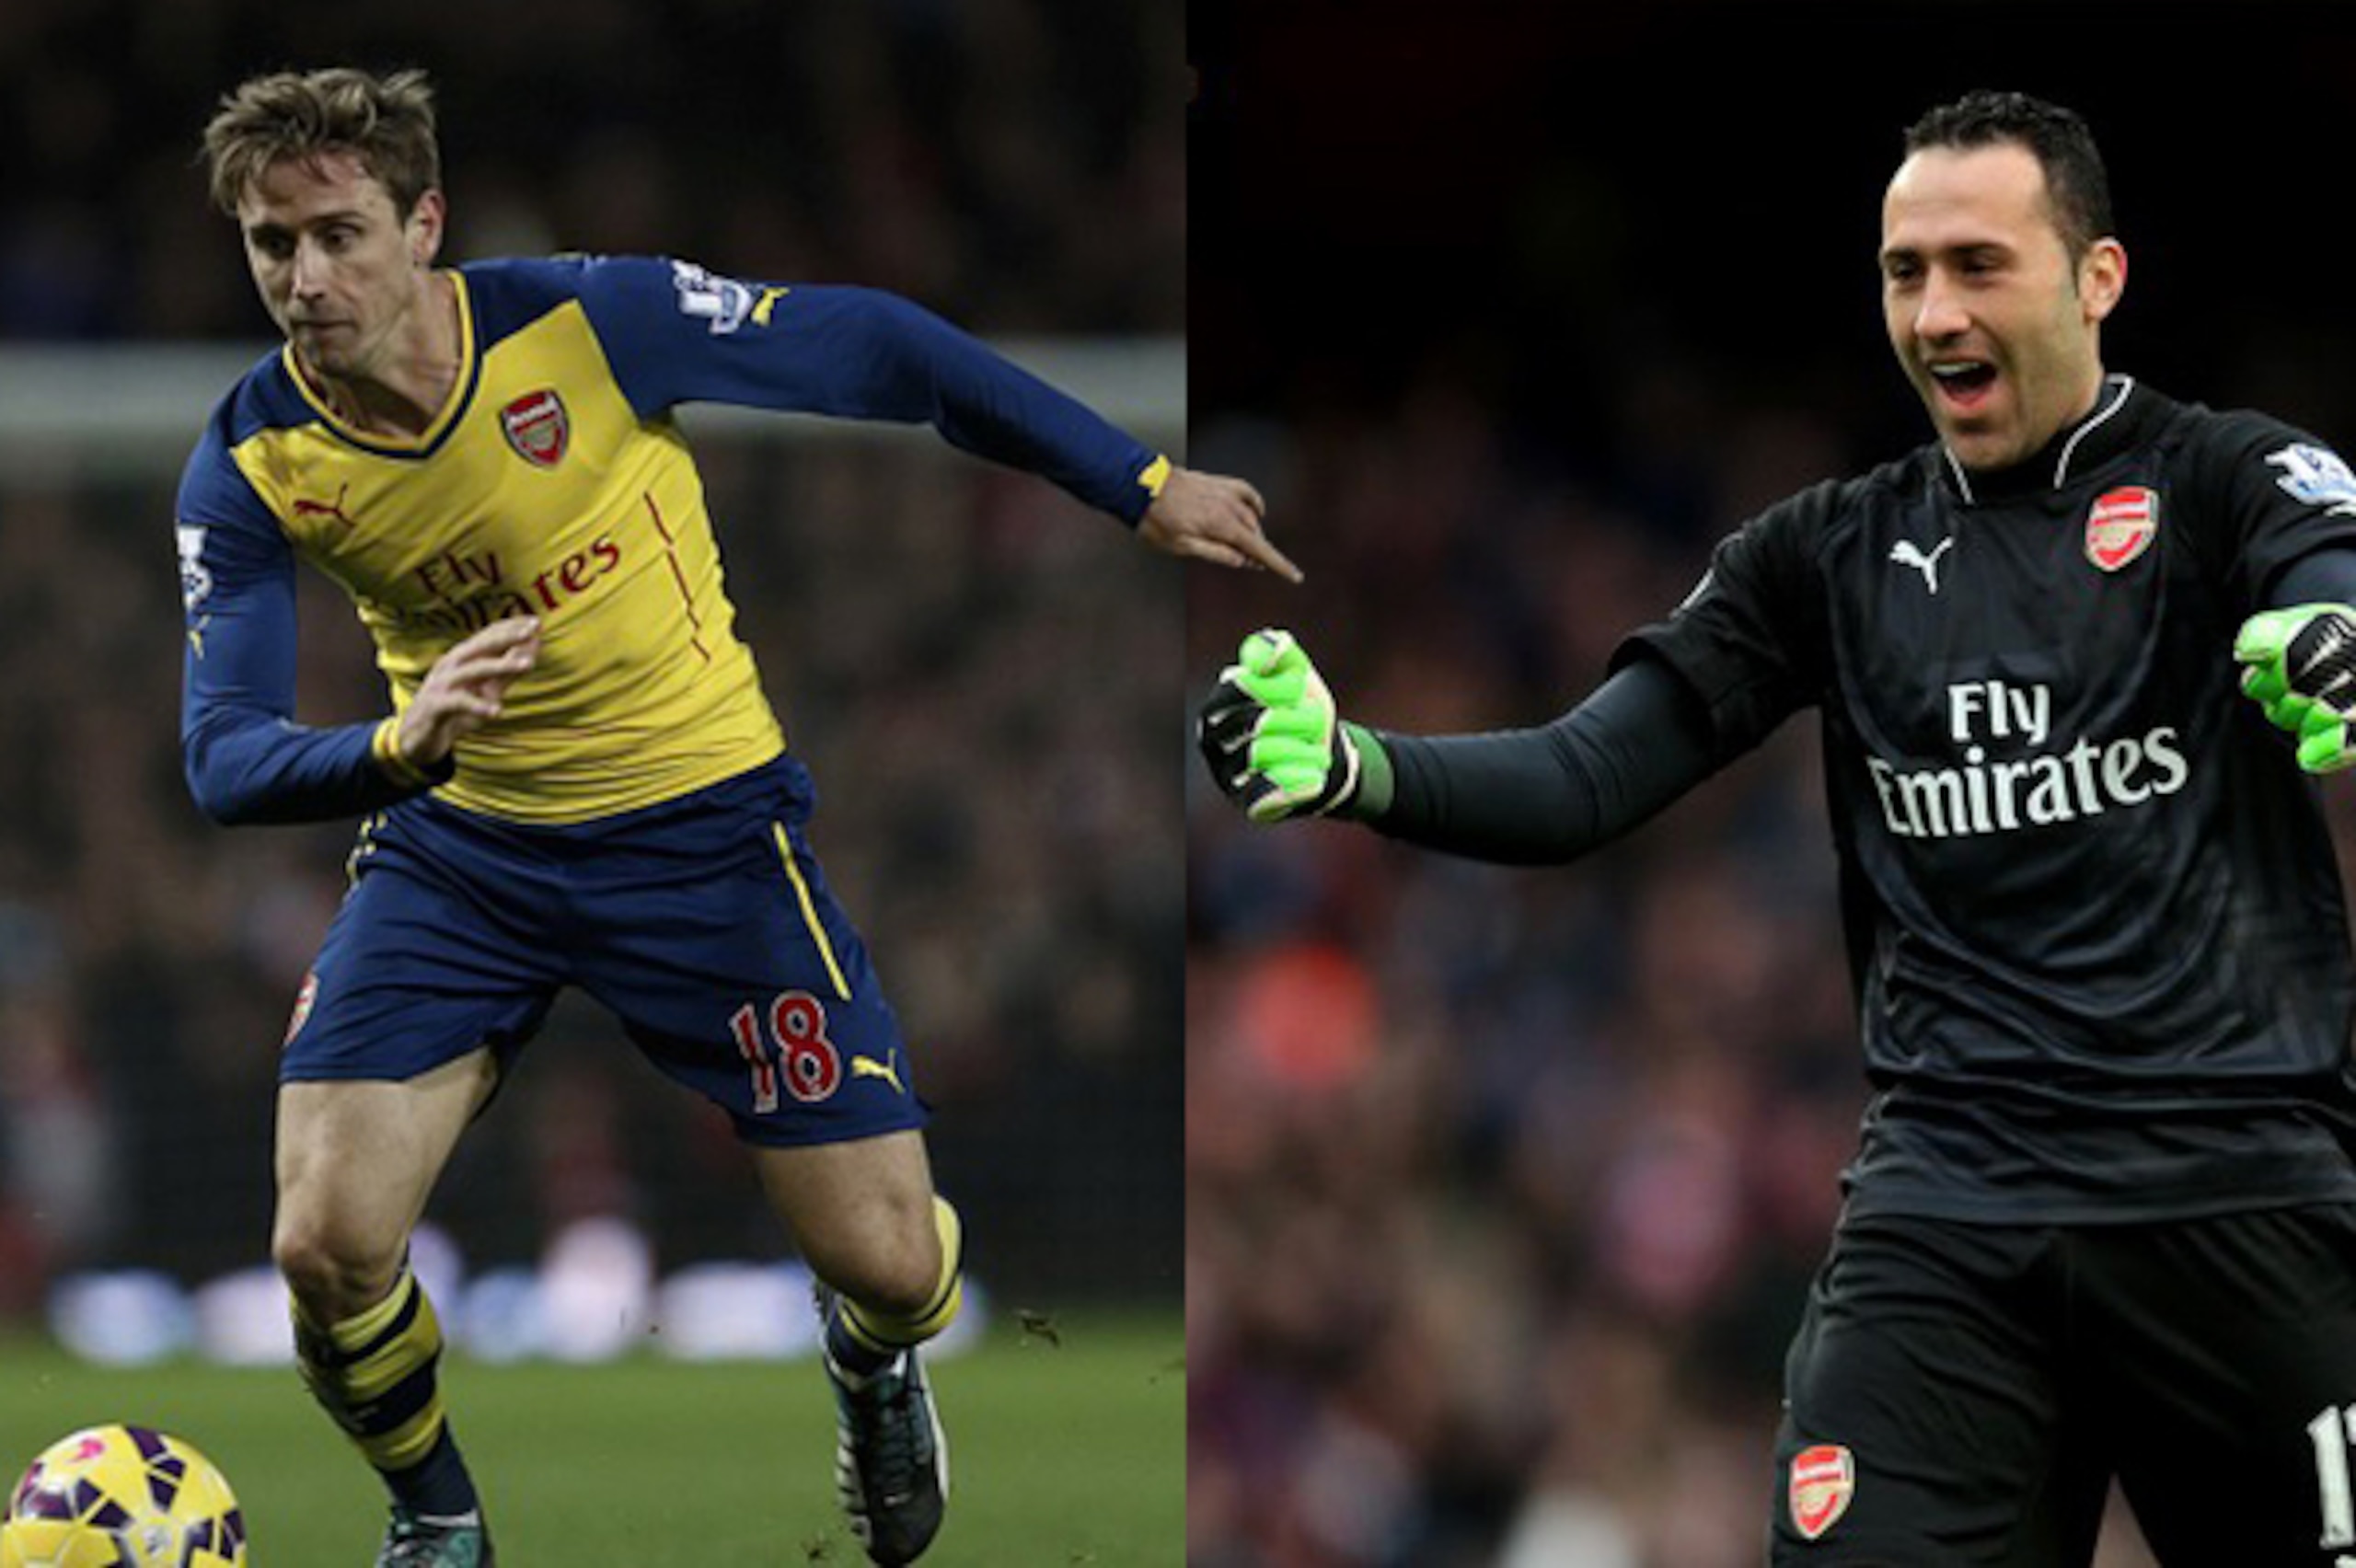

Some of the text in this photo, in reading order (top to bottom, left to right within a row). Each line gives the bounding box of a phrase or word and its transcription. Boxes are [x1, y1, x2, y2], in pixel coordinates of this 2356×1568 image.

[416, 550, 500, 594] Fly
[1947, 680, 2050, 746] Fly
[1866, 727, 2189, 836] Emirates
[728, 989, 841, 1113] 18
